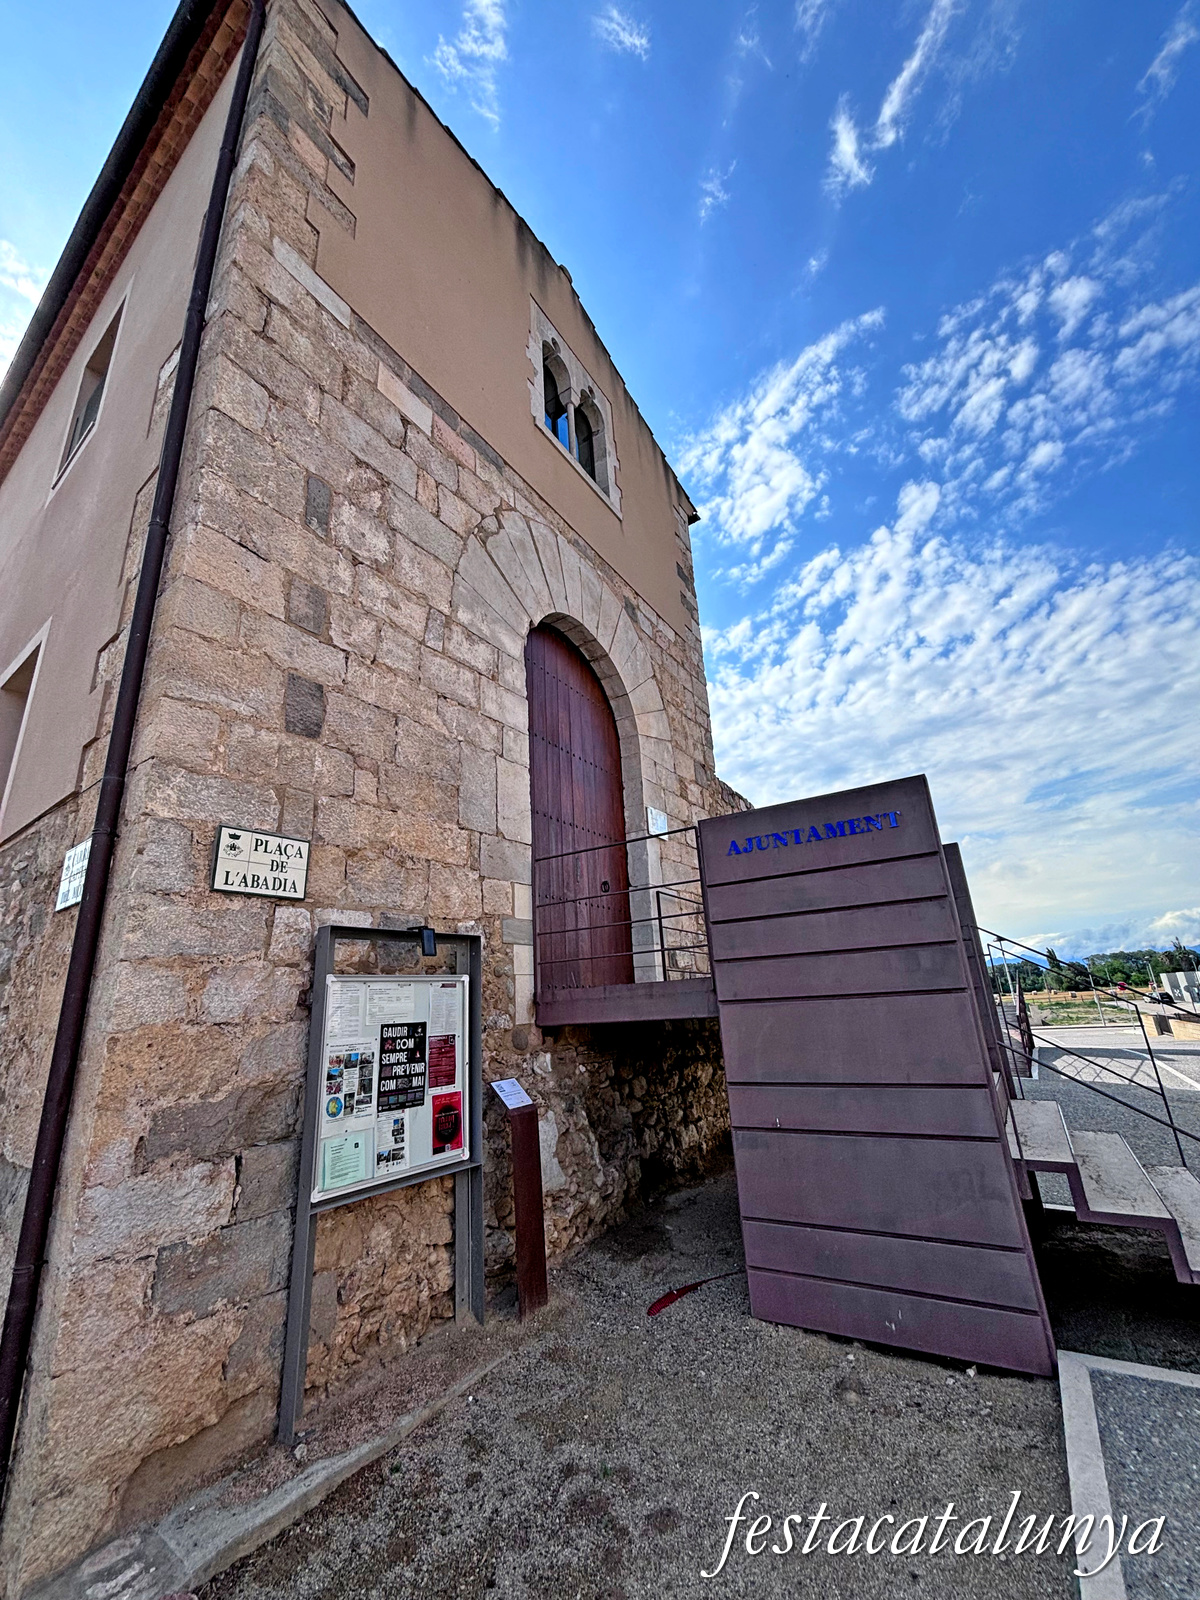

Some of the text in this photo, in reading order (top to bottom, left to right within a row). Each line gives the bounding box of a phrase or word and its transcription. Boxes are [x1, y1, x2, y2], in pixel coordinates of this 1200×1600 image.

[726, 810, 902, 856] AJUNTAMENT
[253, 838, 304, 861] PLAÇA
[269, 858, 289, 874] DE
[223, 870, 298, 893] L'ABADIA
[382, 1026, 408, 1038] GAUDIR
[395, 1038, 414, 1049] COM
[381, 1051, 408, 1065] SEMPRE
[380, 1079, 396, 1092] COM
[411, 1075, 425, 1088] MAI
